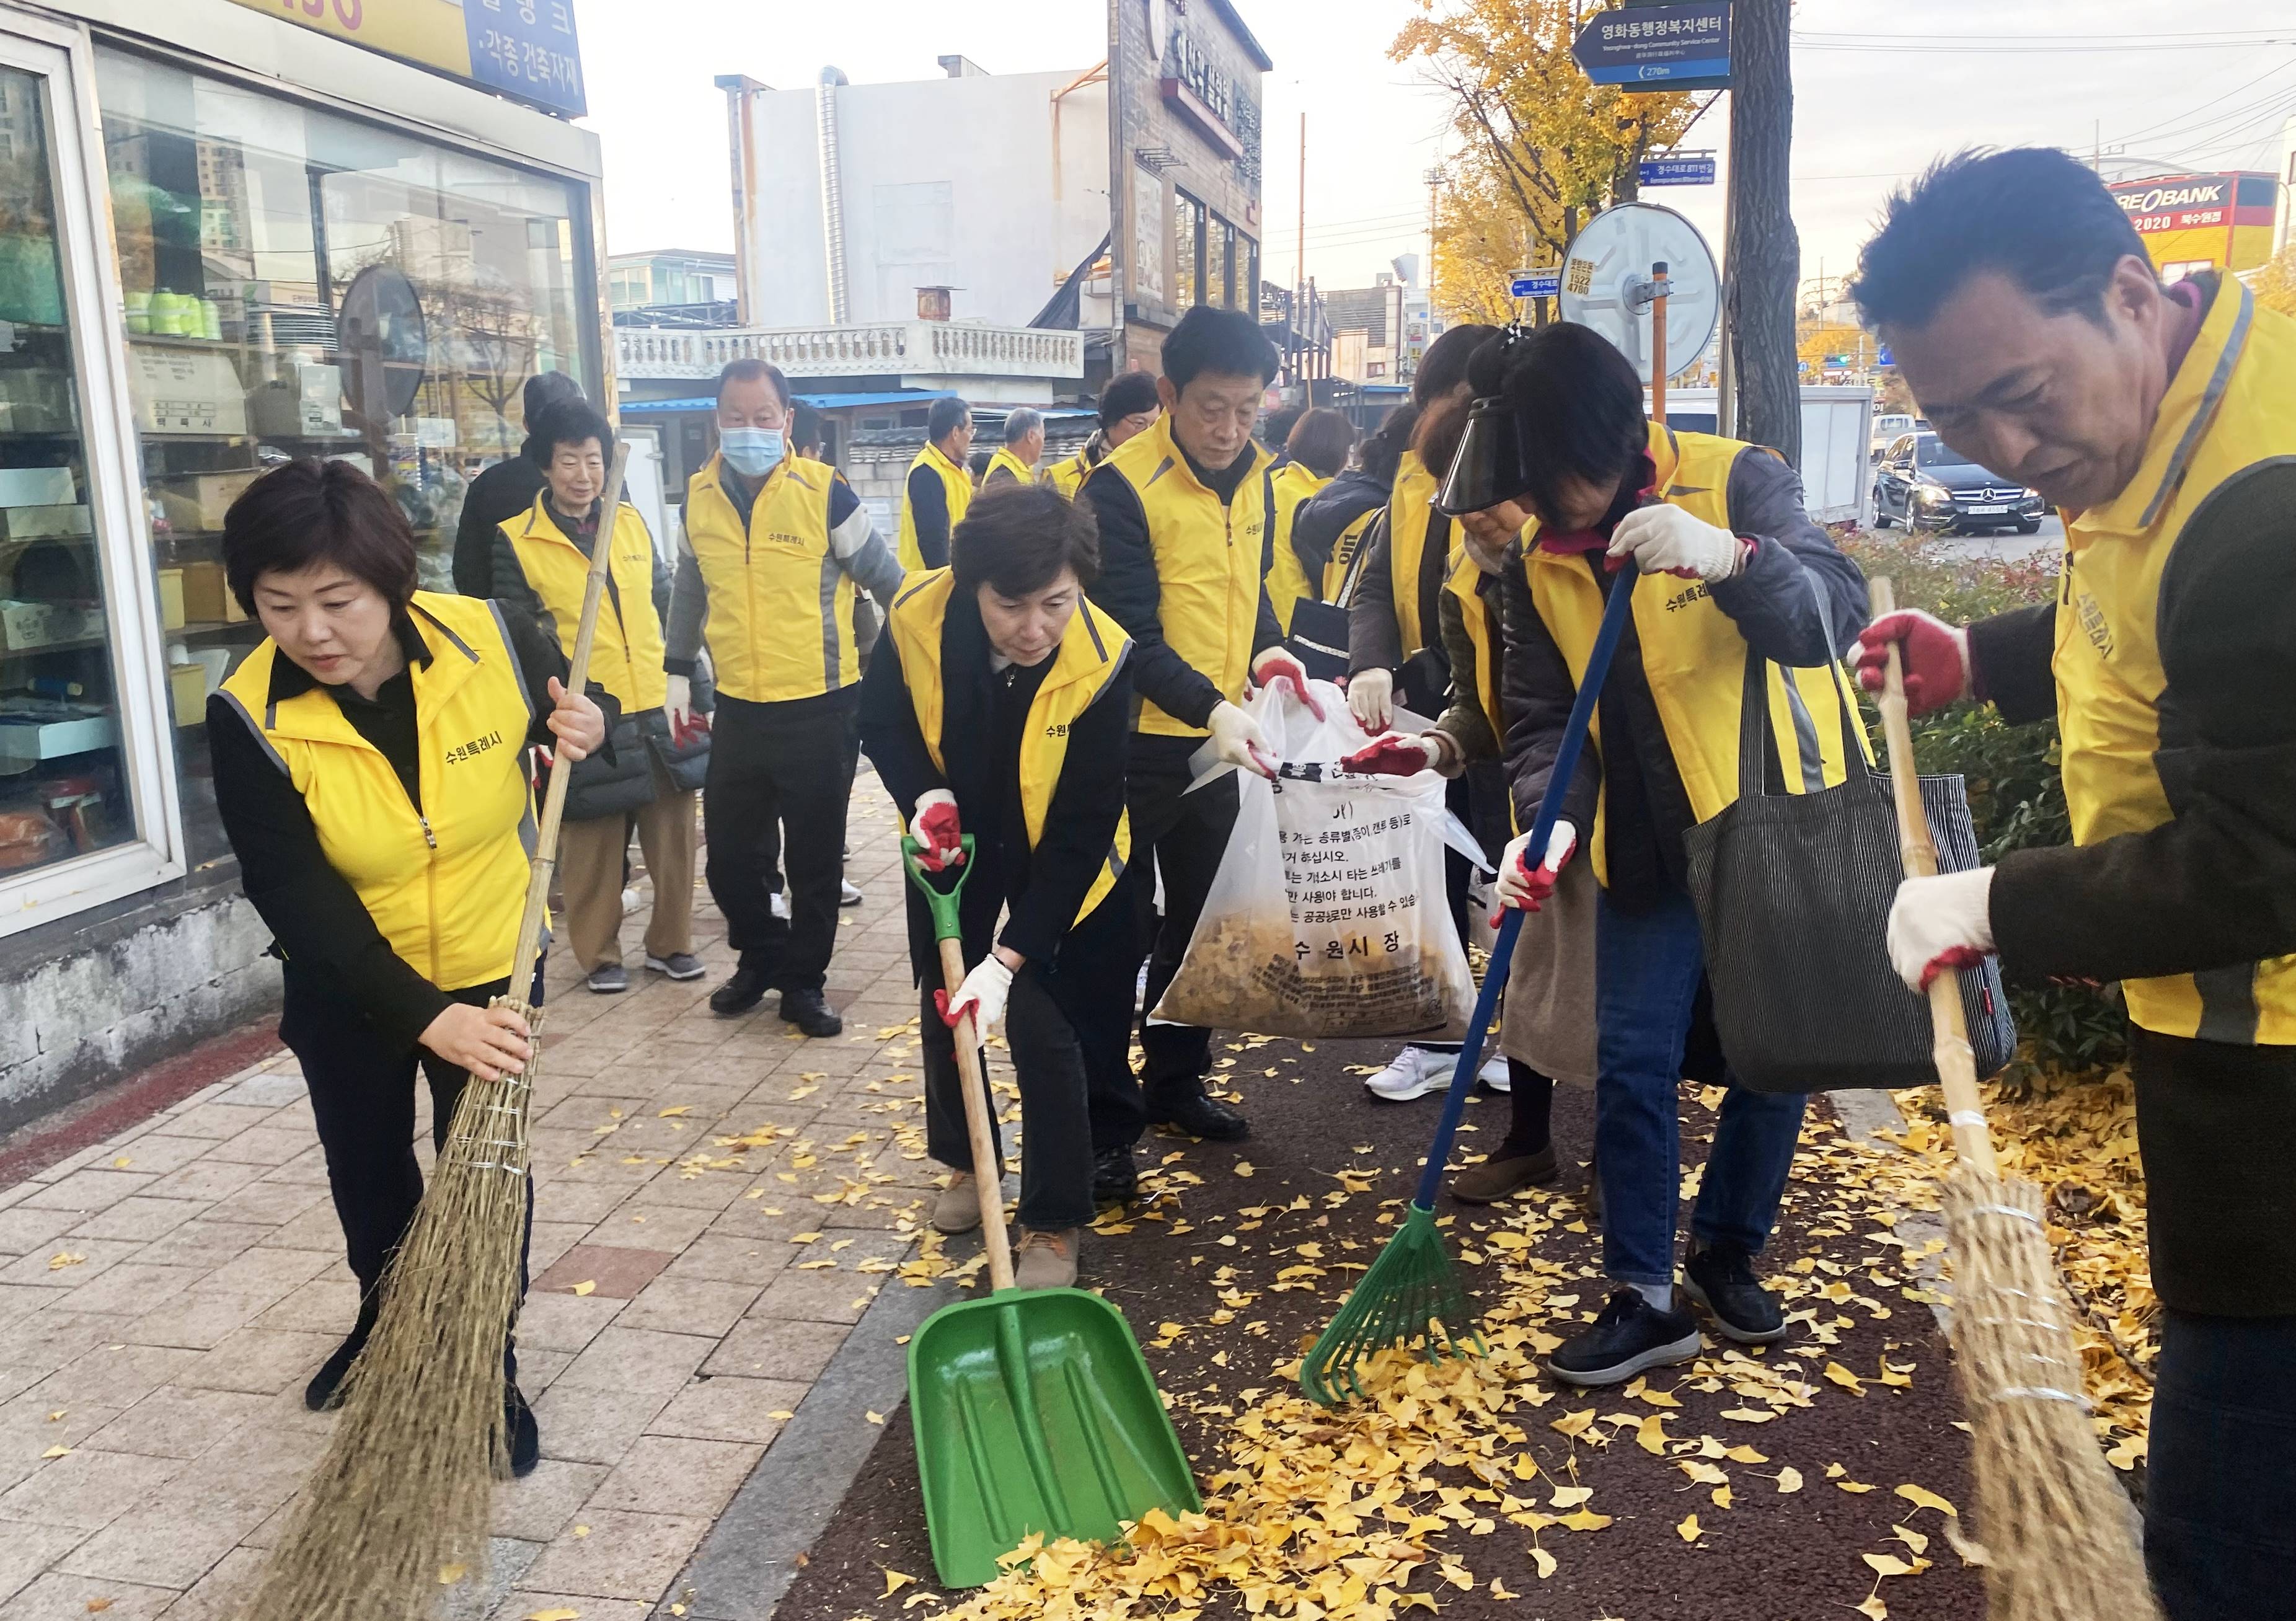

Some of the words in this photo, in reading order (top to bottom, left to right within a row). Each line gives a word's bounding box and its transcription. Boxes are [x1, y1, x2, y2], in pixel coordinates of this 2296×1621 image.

[1601, 16, 1722, 40] 영화동행정복지센터
[522, 42, 580, 96] 건축자재
[1646, 67, 1670, 76] 270m
[1570, 273, 1591, 286] 1522
[1567, 283, 1589, 295] 4780
[445, 730, 503, 765] 수원특례시
[1346, 868, 1368, 881] 타는
